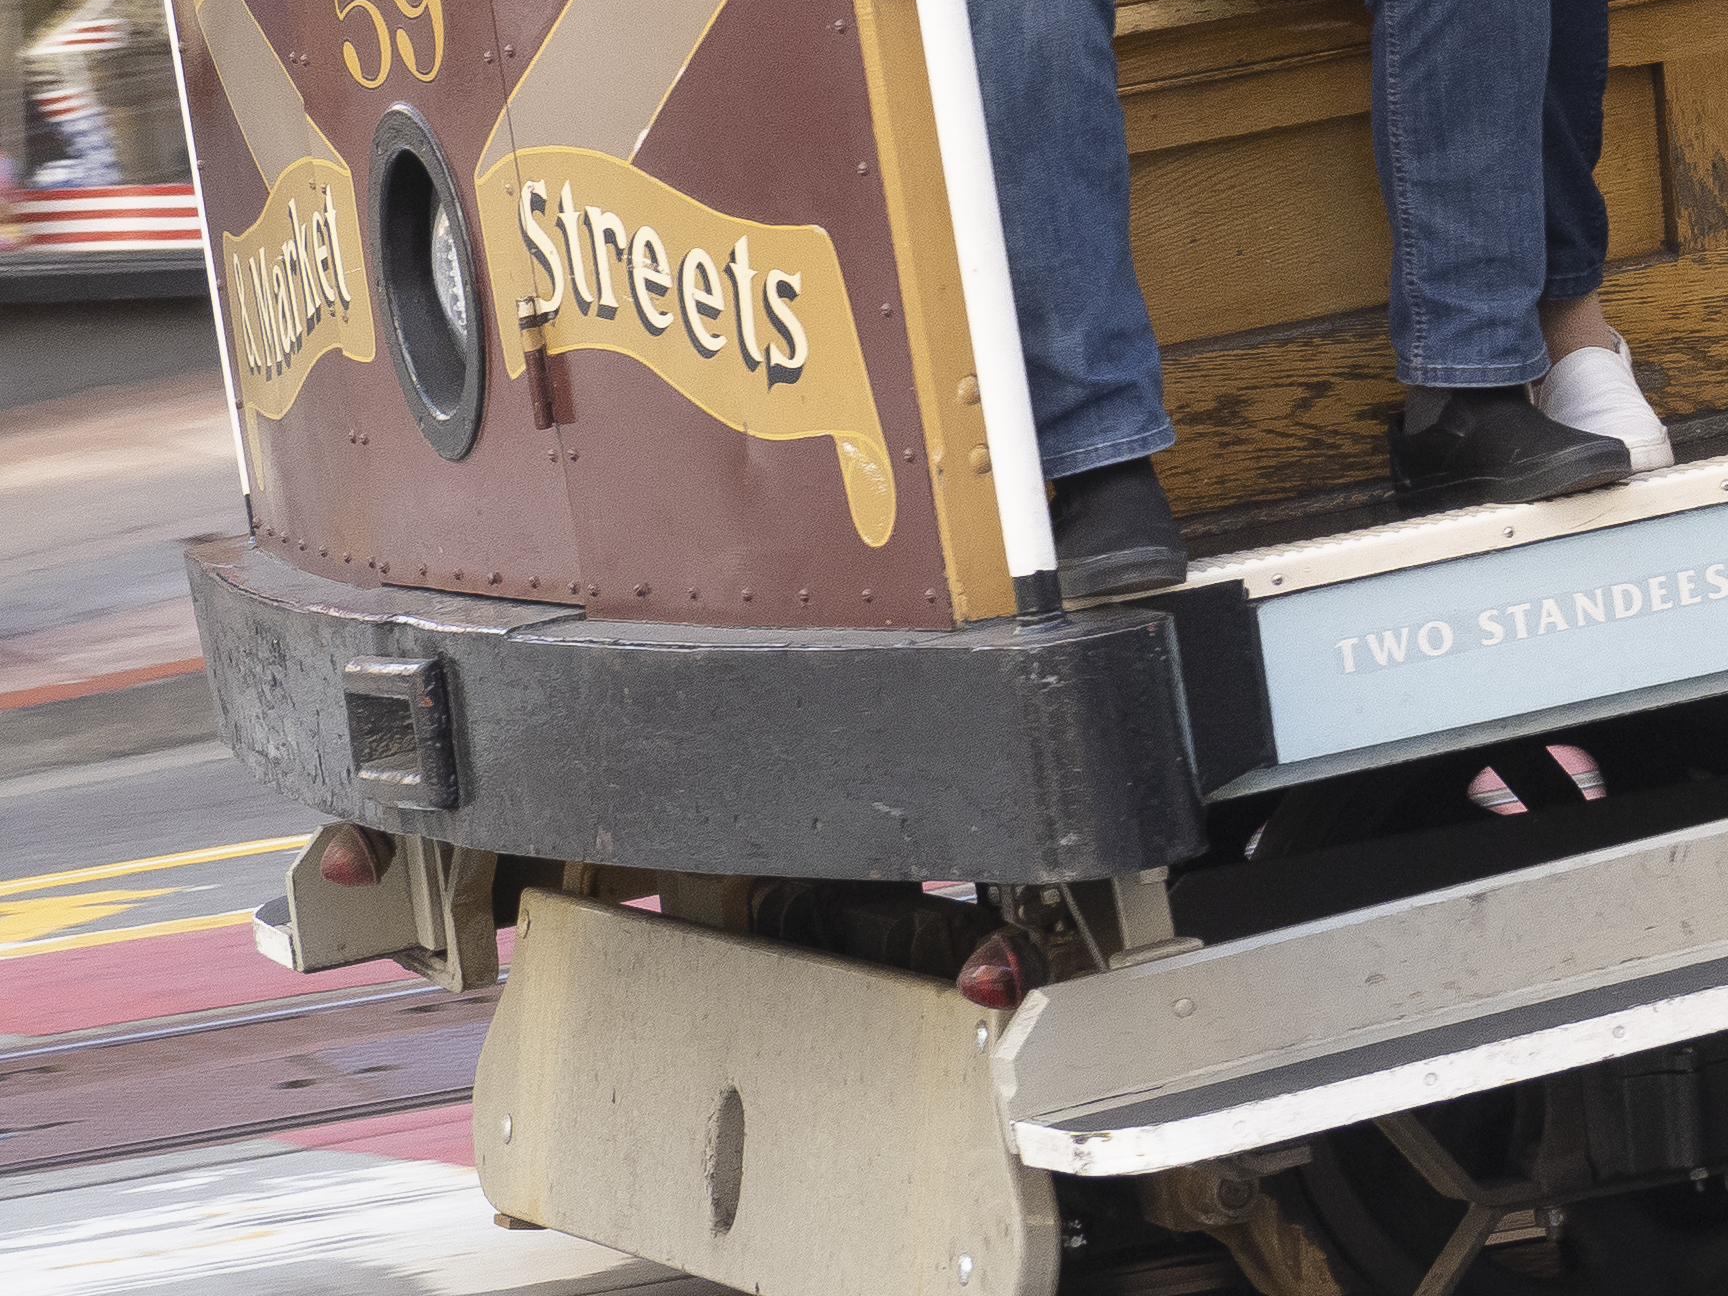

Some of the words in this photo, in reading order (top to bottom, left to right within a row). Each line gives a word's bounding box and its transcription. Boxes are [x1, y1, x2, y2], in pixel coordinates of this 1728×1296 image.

[233, 252, 262, 375] &
[248, 184, 352, 382] Market
[518, 177, 810, 392] Streets
[1335, 618, 1455, 675] TWO
